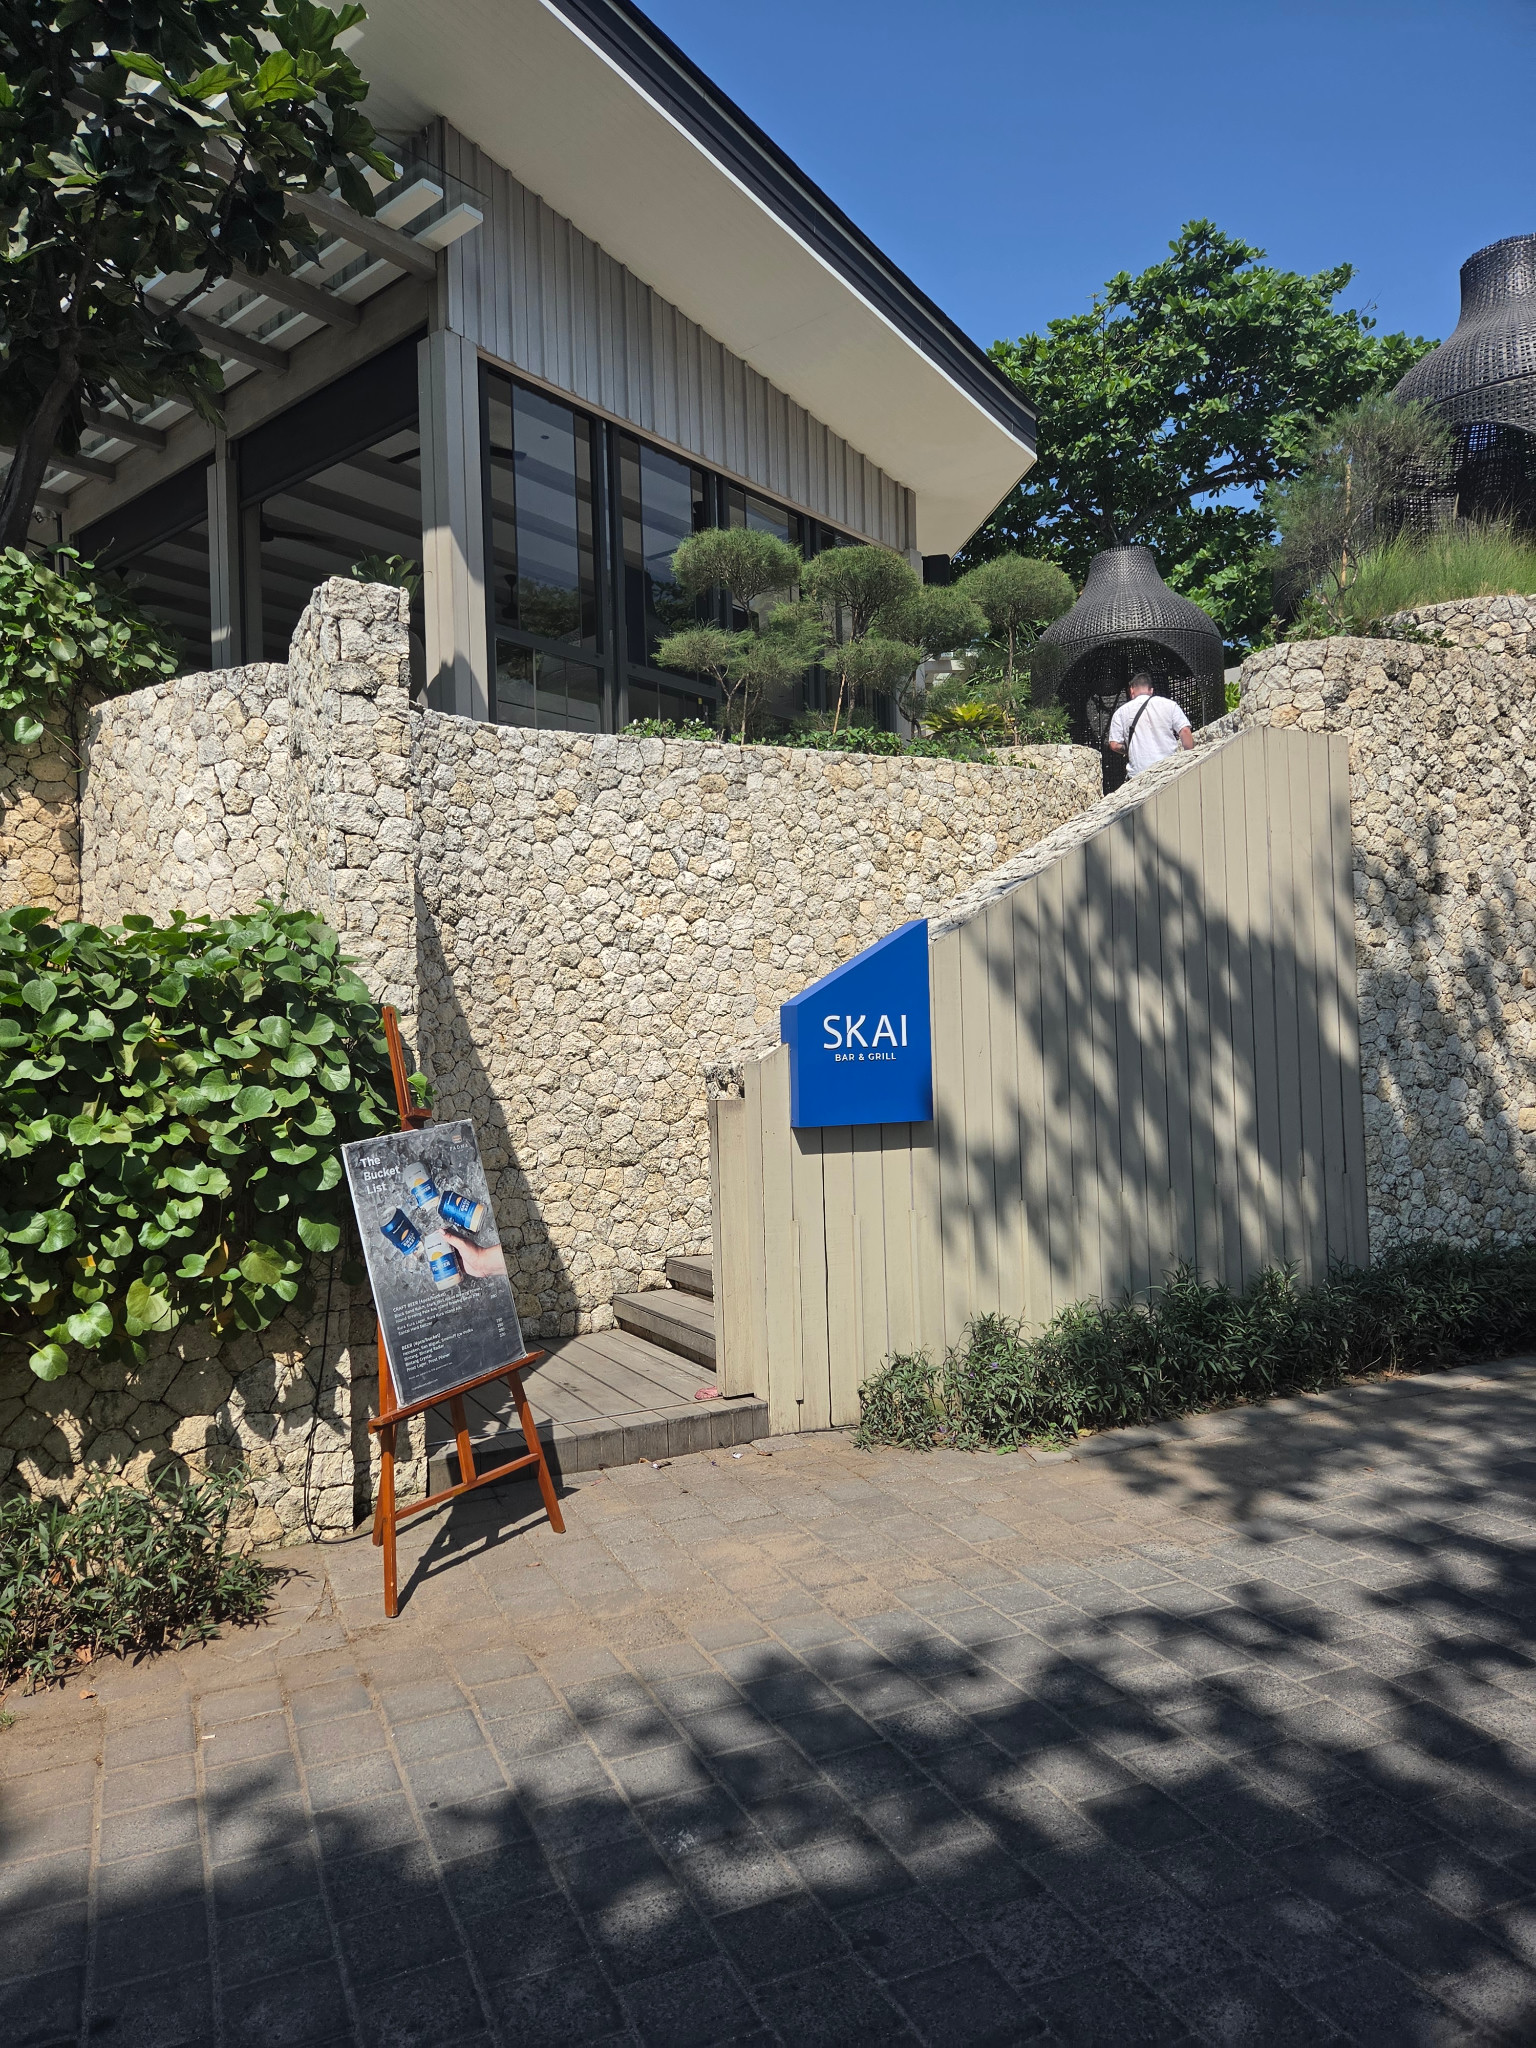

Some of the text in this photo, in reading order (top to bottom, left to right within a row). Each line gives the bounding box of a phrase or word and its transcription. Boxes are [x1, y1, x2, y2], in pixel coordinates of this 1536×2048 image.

[823, 1014, 908, 1050] SKAI
[834, 1052, 897, 1062] BAR & GRILL
[360, 1155, 381, 1168] The
[363, 1165, 400, 1181] Bucket
[366, 1181, 387, 1195] List
[393, 1305, 407, 1313] CRAFT
[402, 1343, 413, 1351] BEER
